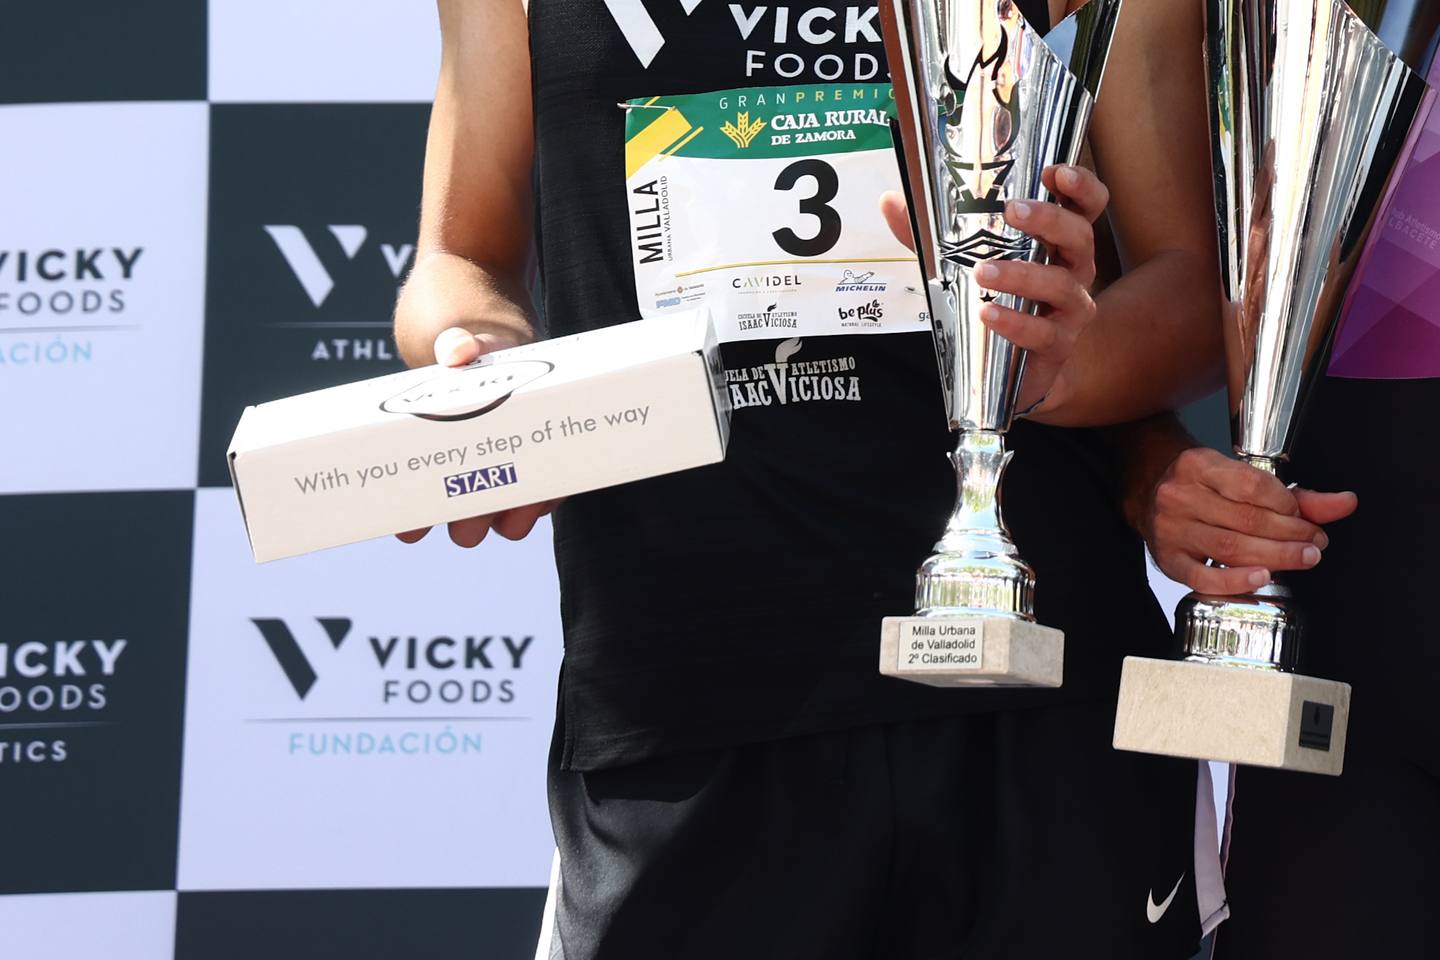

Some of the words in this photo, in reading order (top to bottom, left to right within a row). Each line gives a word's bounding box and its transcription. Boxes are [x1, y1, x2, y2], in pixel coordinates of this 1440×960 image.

[728, 3, 883, 46] VICK
[746, 49, 893, 82] FOOD
[770, 113, 819, 131] CAJA
[825, 108, 891, 128] RURAL
[771, 134, 787, 146] DE
[796, 129, 857, 144] ZAMORA
[660, 175, 672, 233] VALLADOLID
[772, 158, 842, 257] 3
[633, 179, 664, 265] MILLA
[739, 318, 763, 331] ISAAC
[763, 313, 798, 329] VICIOSA
[838, 306, 855, 321] be
[857, 301, 884, 321] plus
[751, 365, 766, 380] DE
[791, 356, 857, 376] ATLETISMO
[729, 380, 773, 410] AAC
[764, 363, 862, 405] VICIOSA
[294, 467, 350, 495] With
[357, 461, 399, 488] you
[407, 445, 468, 471] every
[476, 434, 523, 455] step
[531, 420, 553, 444] of
[560, 416, 597, 437] the
[604, 406, 650, 426] way
[446, 464, 517, 497] START
[911, 640, 924, 650] de
[927, 640, 976, 650] Valladolid
[912, 625, 936, 636] Milla
[939, 625, 976, 636] Urbana
[0, 639, 128, 679] ICKY
[368, 636, 535, 670] VICKY
[908, 652, 920, 664] 2º
[921, 652, 978, 664] Clasificado
[0, 683, 107, 712] OODS
[383, 679, 515, 704] FOODS
[288, 724, 483, 757] FUNDACIÓN
